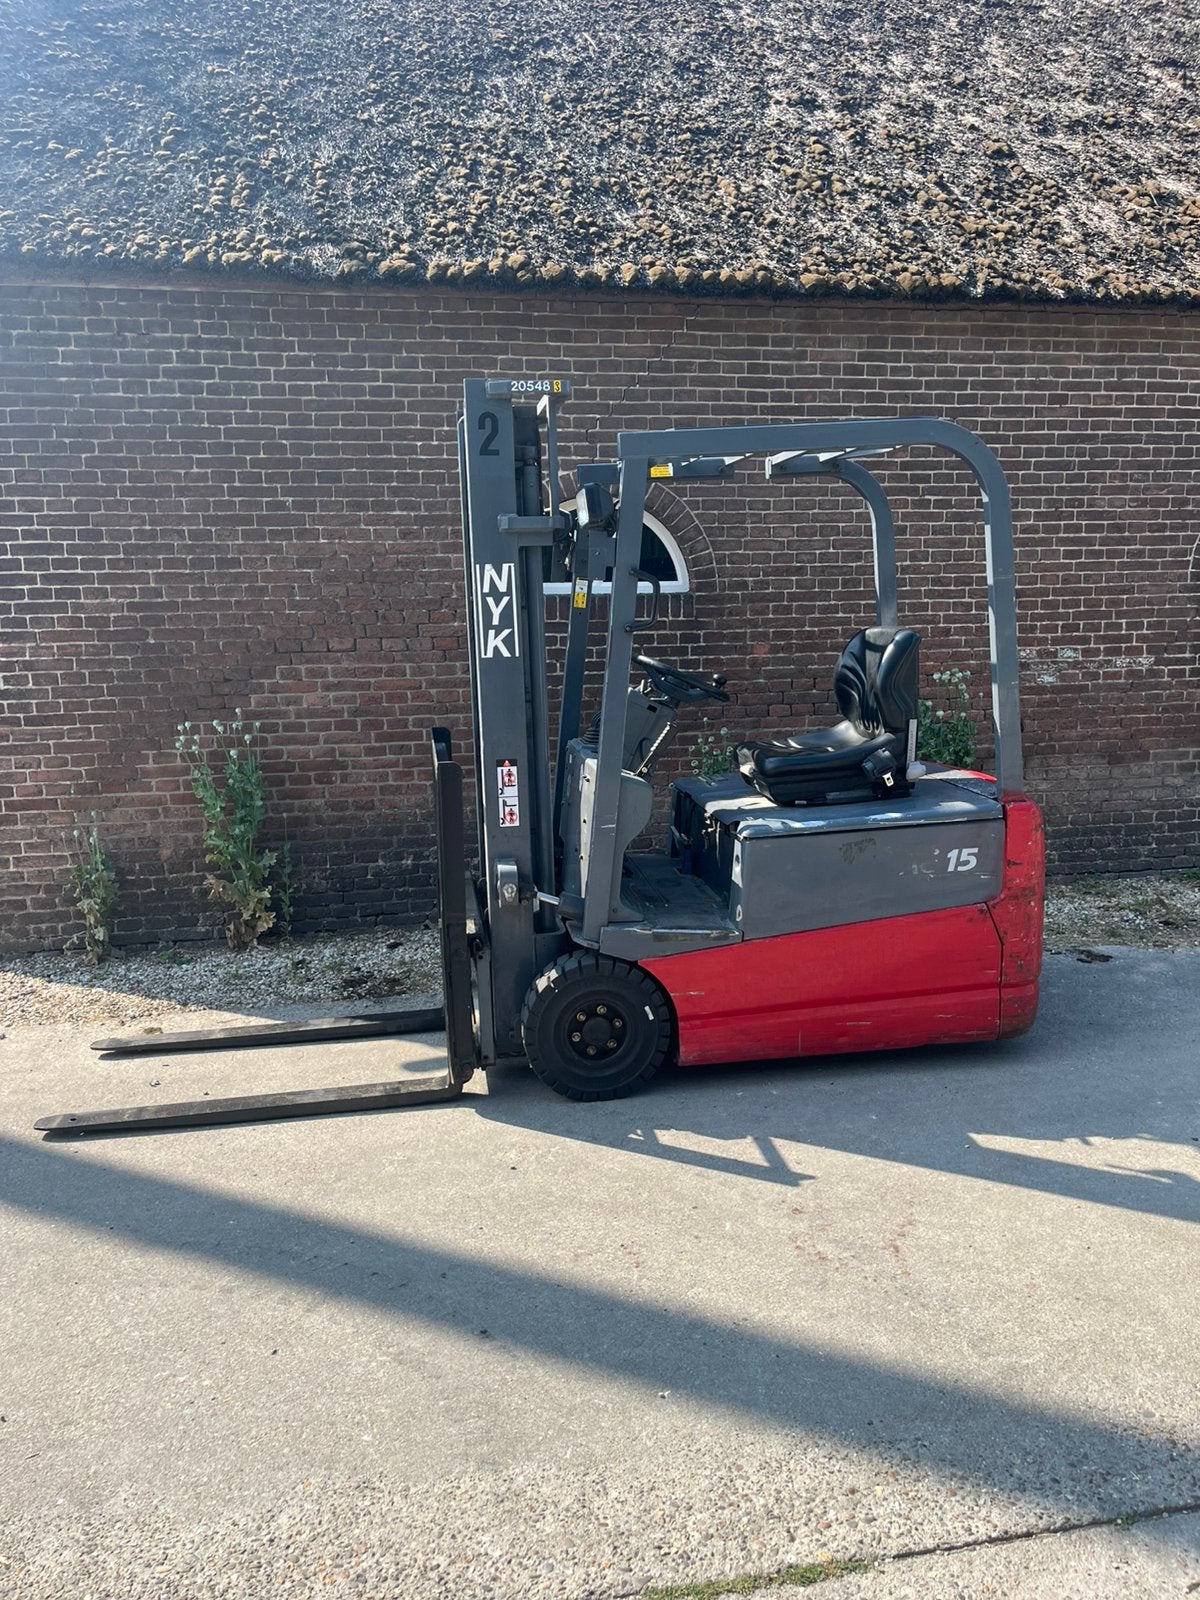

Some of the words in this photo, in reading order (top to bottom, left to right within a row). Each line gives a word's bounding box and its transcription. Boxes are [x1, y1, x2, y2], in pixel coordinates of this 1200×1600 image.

[511, 380, 551, 392] 20548
[477, 411, 500, 456] 2
[478, 563, 517, 659] NYK
[946, 847, 979, 872] 15
